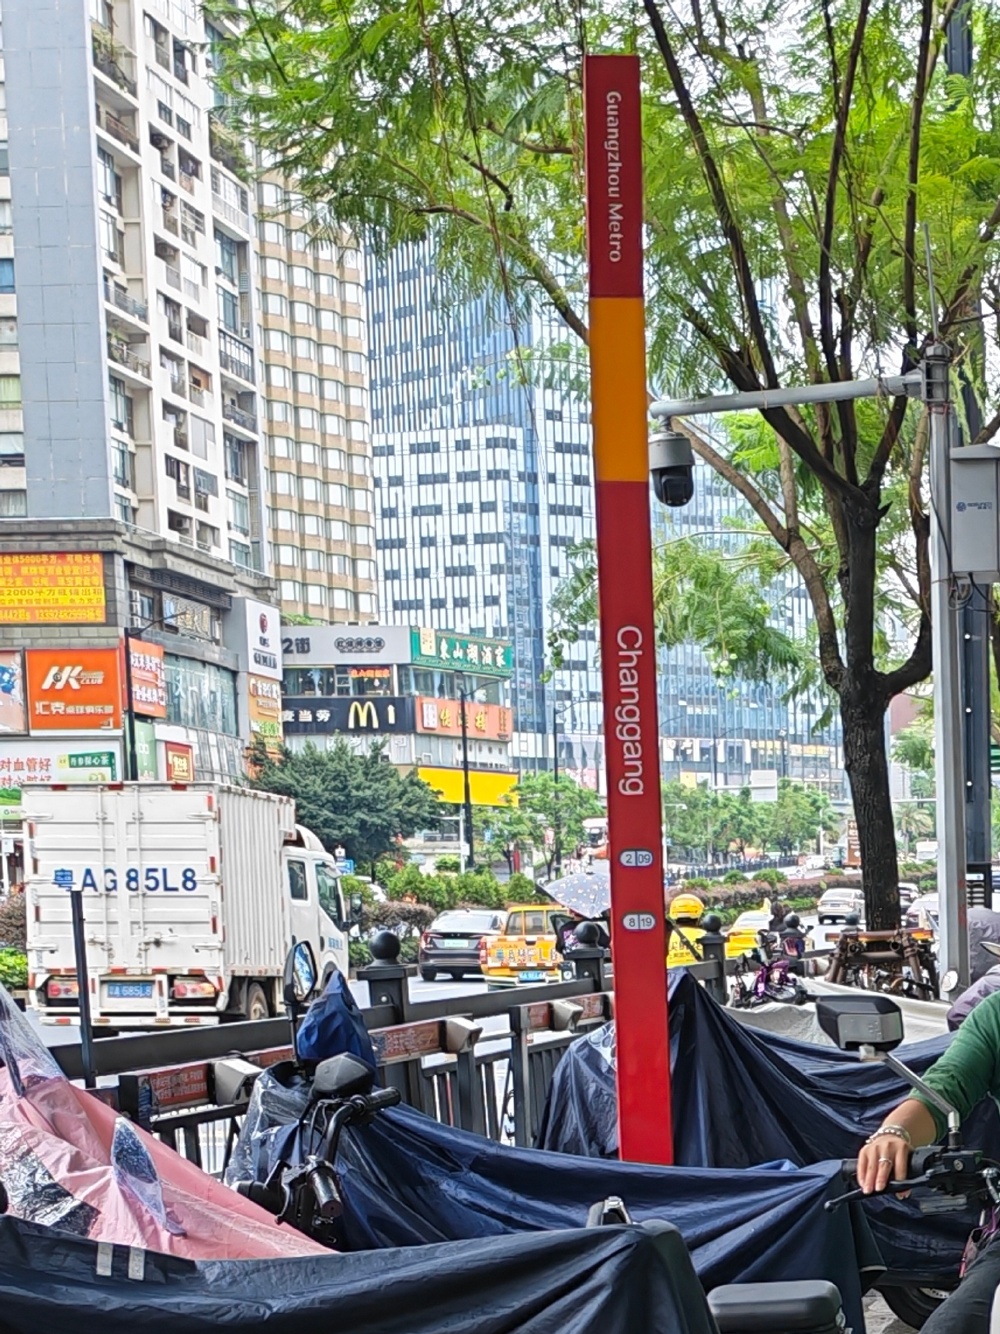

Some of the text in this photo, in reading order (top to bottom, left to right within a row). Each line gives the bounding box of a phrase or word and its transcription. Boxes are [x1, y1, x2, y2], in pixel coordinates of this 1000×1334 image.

[604, 91, 624, 263] Guangzhou Metro
[615, 625, 643, 796] Changgang
[625, 853, 651, 864] 2 09
[628, 916, 652, 928] 8 19
